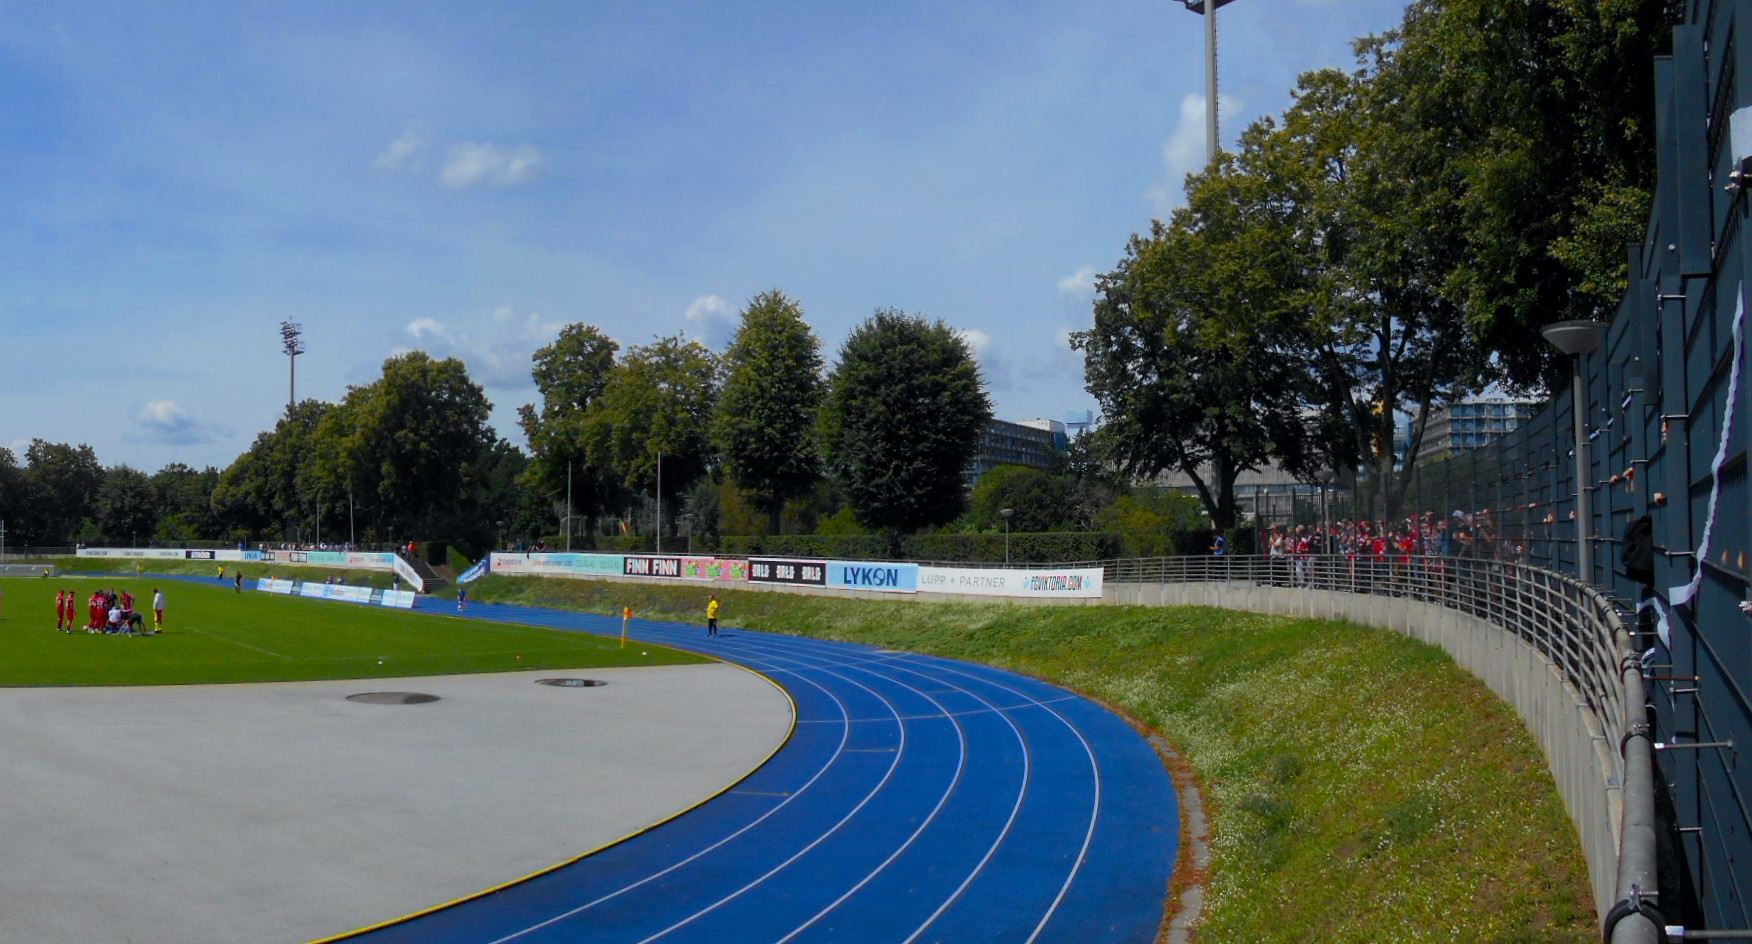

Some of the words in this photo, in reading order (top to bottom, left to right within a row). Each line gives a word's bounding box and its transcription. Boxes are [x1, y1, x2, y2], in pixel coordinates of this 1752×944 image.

[626, 558, 649, 574] FINN
[652, 559, 677, 575] FINN
[843, 567, 898, 586] LYKON
[921, 574, 946, 585] LUPP
[959, 576, 1006, 588] PARTNER
[1031, 575, 1082, 591] FCVIKTORIA.COM
